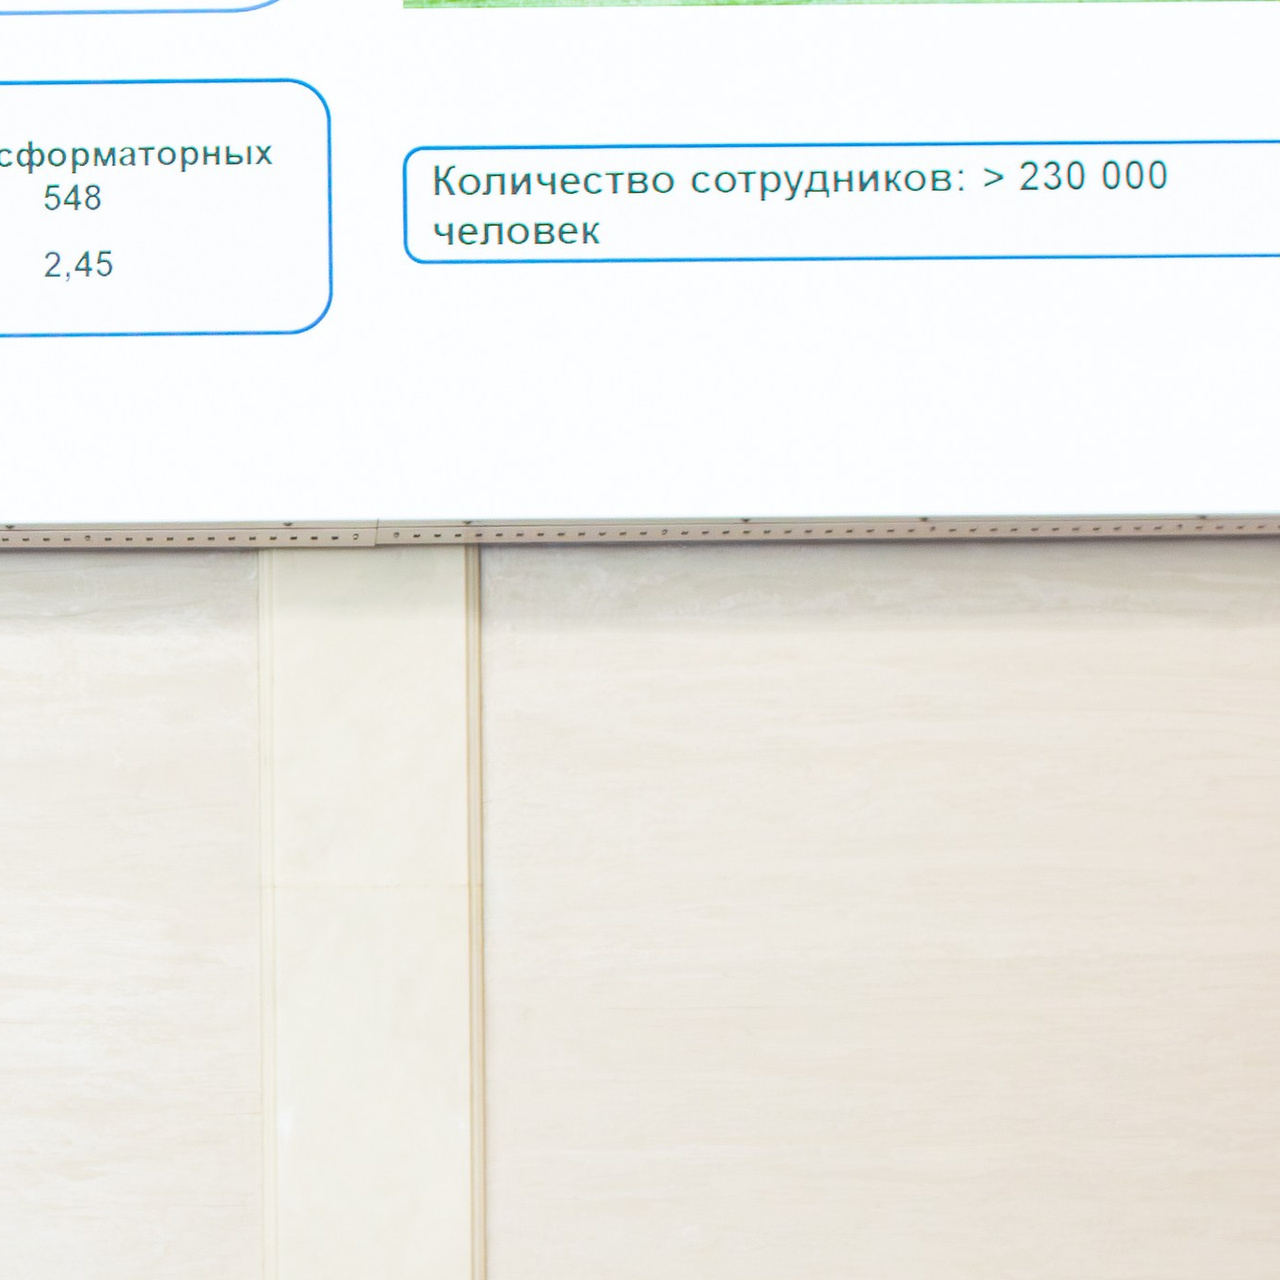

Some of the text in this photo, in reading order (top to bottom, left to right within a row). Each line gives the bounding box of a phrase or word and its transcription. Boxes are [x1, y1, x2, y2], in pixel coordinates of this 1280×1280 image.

[432, 158, 1169, 203] Количество сотрудников: > 230 000
[43, 182, 103, 212] 548
[432, 220, 602, 246] человек
[43, 249, 114, 283] 2,45
